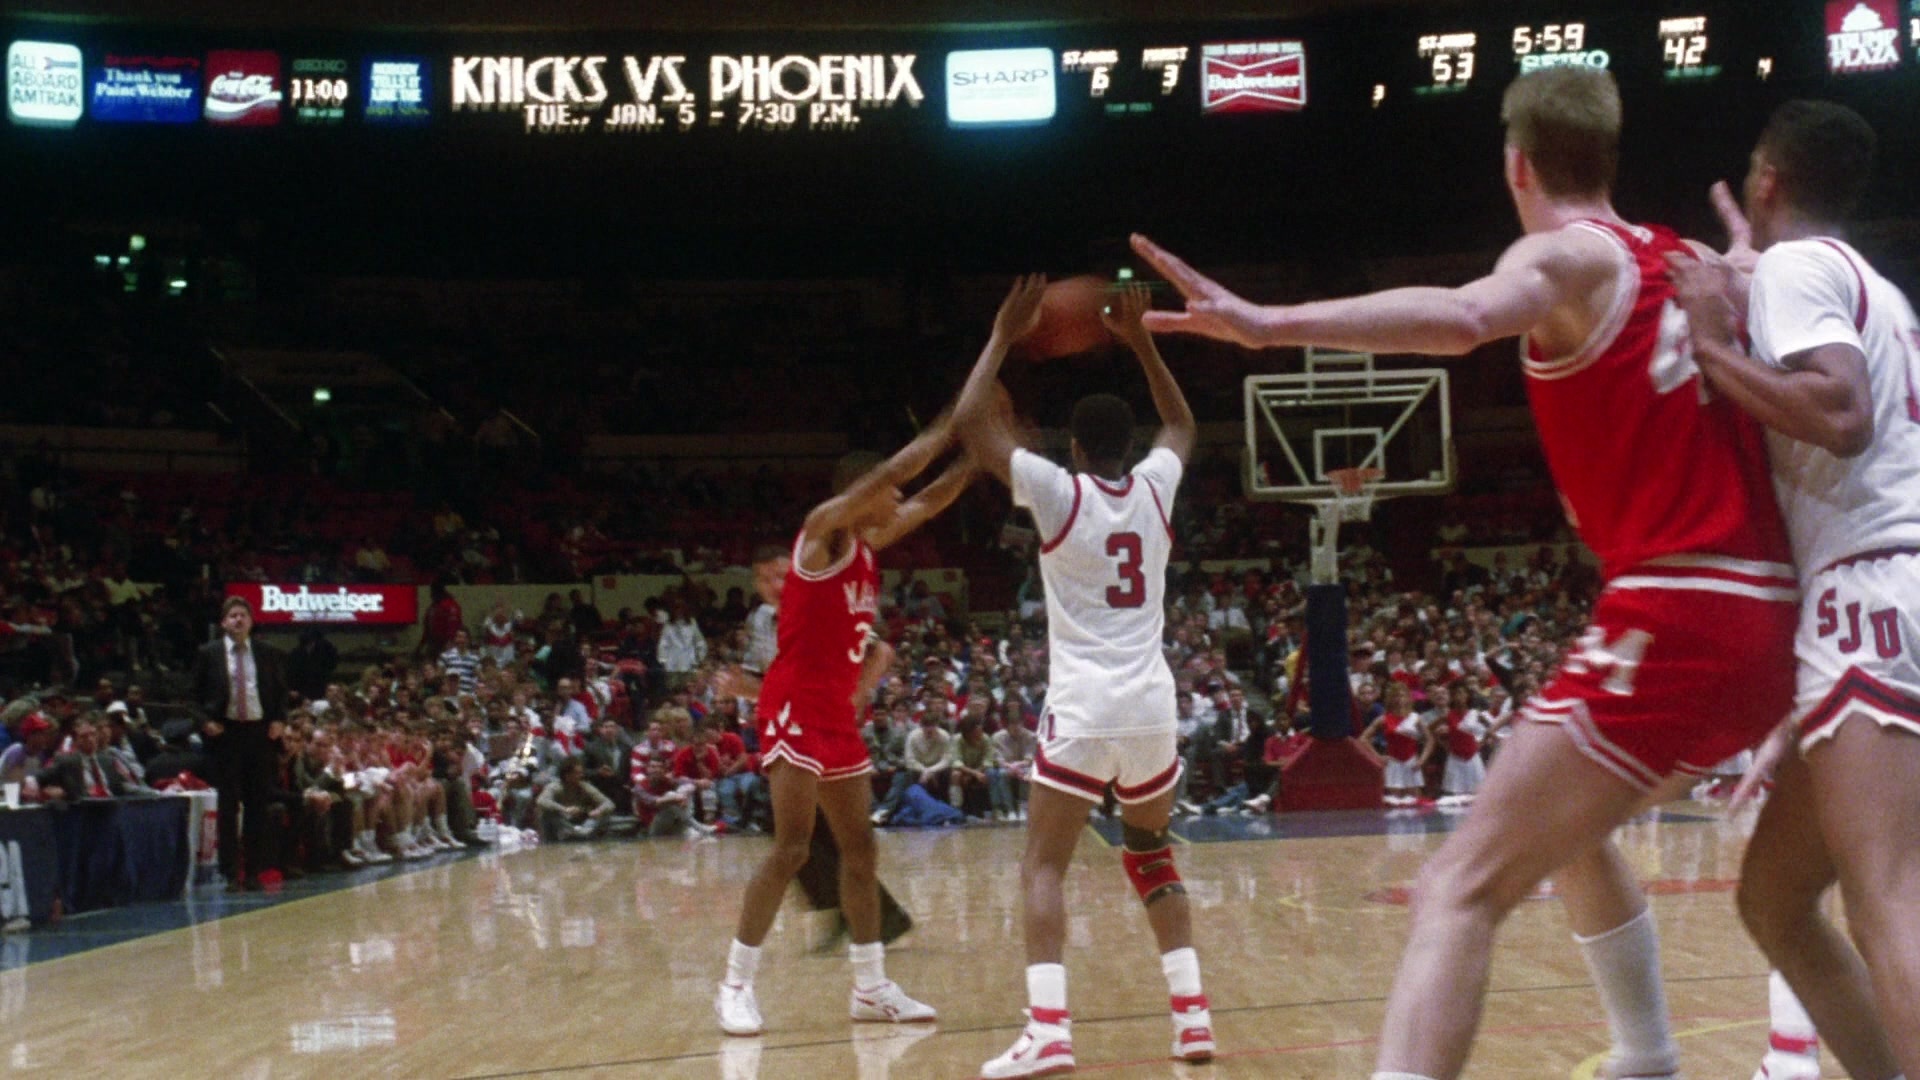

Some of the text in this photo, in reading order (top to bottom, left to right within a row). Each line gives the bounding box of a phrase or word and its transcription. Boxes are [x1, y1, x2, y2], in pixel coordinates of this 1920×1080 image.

[1513, 23, 1585, 55] 5:59
[1665, 36, 1707, 65] 42
[12, 53, 37, 68] ALL
[1433, 52, 1475, 82] 53
[1830, 46, 1900, 68] PLAZA
[12, 71, 79, 90] ABOARD
[105, 68, 181, 86] Thank you
[452, 54, 924, 103] KNICKS VS. PHOENIX
[953, 68, 1048, 87] SHARP
[1092, 67, 1109, 90] 6
[1162, 64, 1178, 87] 3
[1207, 72, 1300, 90] Budweiser
[12, 88, 80, 108] AMTRAK
[290, 78, 348, 101] 11:00
[606, 103, 664, 125] JAN.
[679, 102, 696, 124] 5
[739, 102, 796, 124] 7:30
[810, 102, 860, 123] P.M.
[1105, 532, 1146, 608] 3
[261, 584, 384, 612] Budweiser
[1816, 588, 1903, 660] SJU
